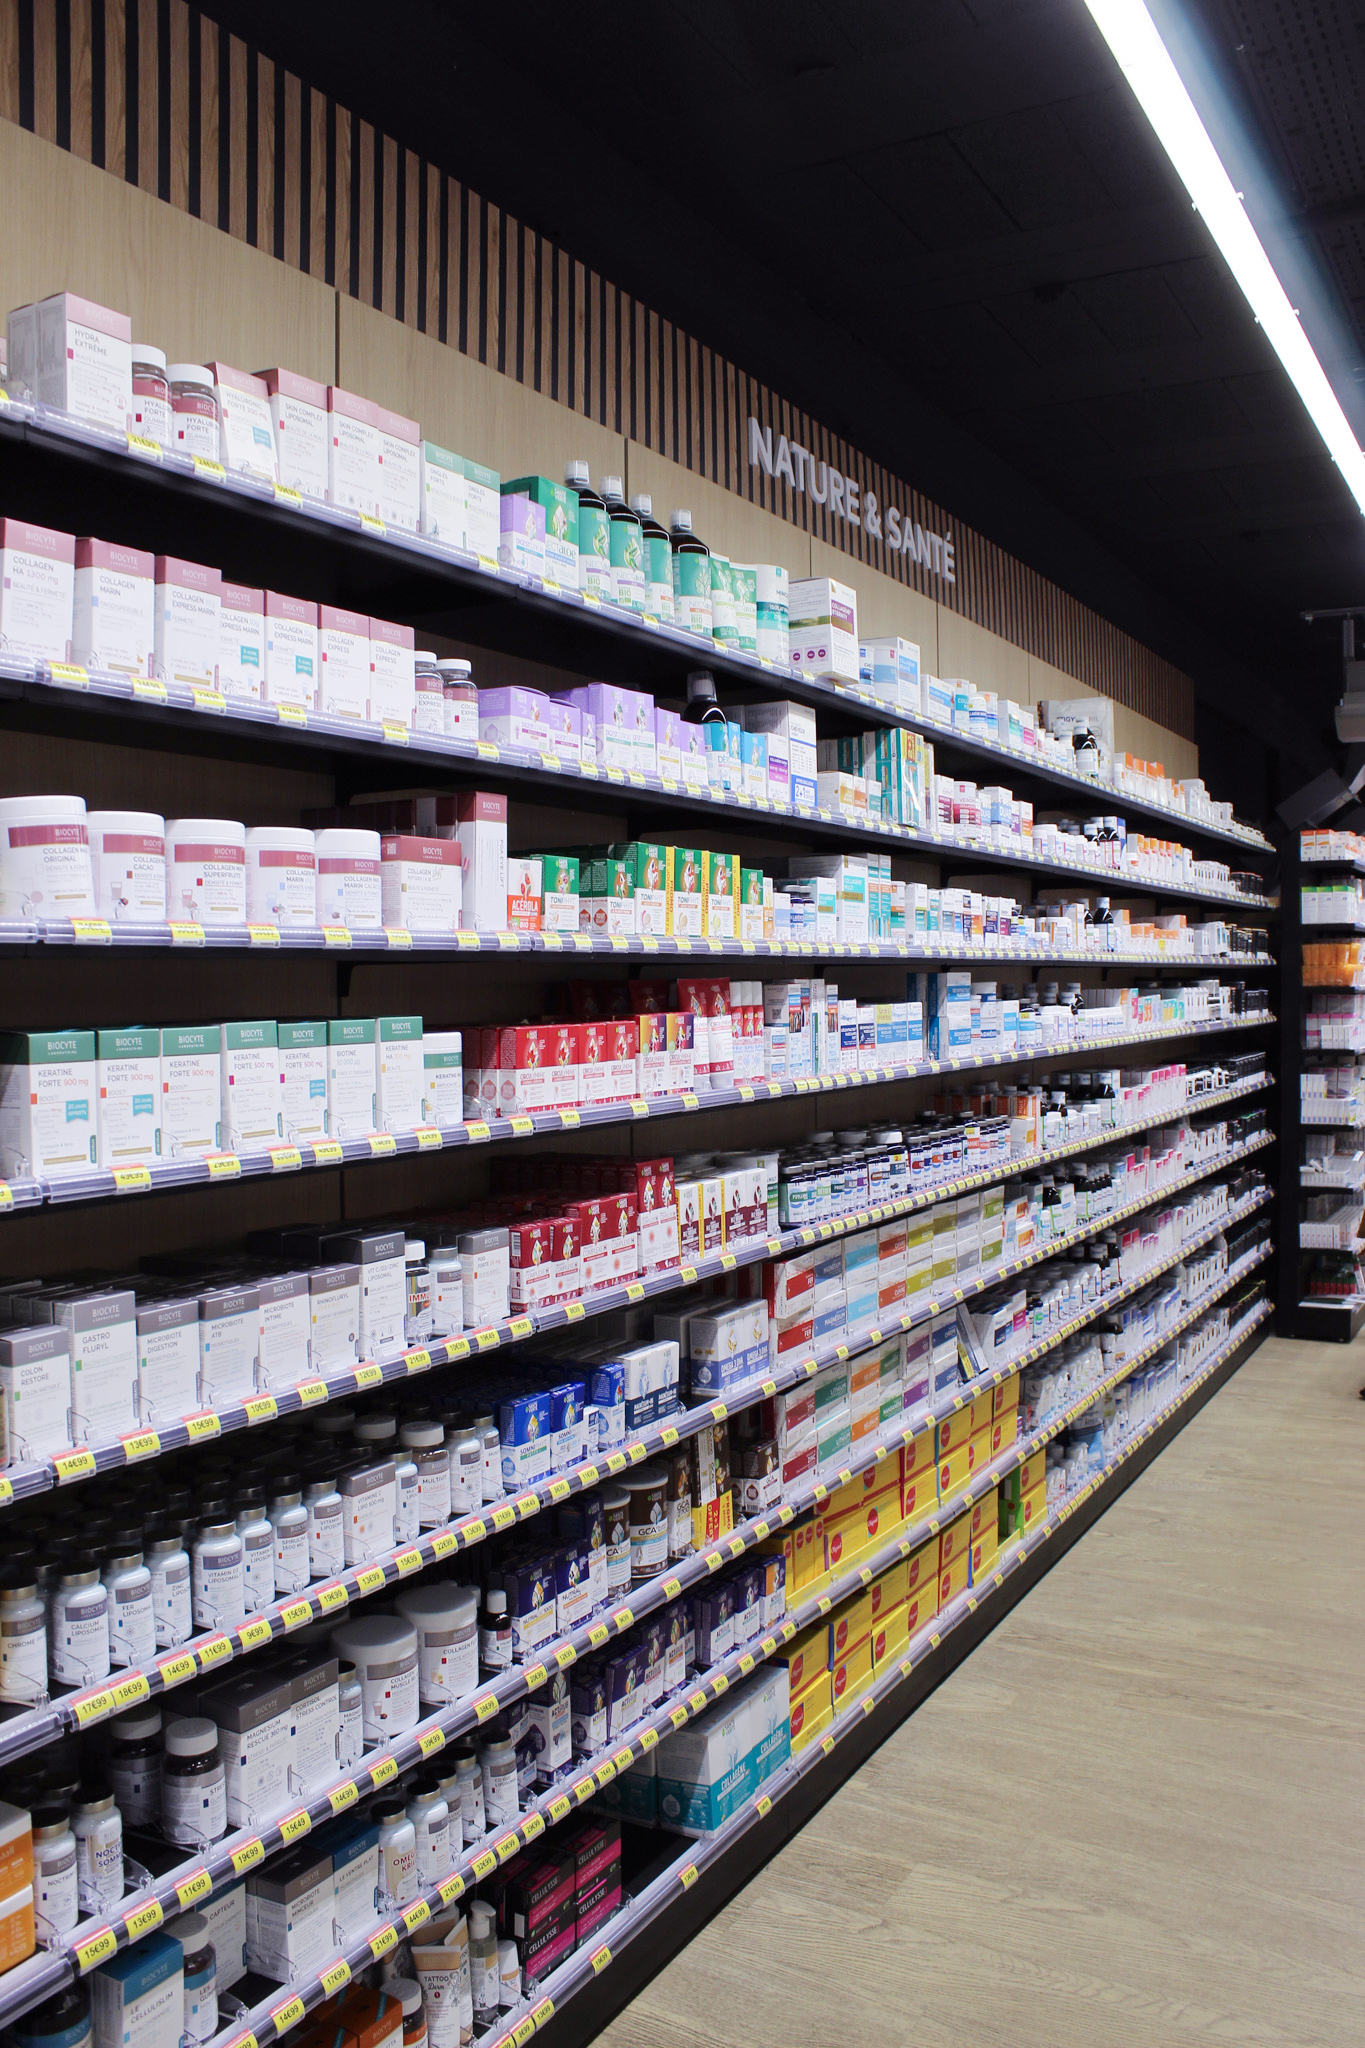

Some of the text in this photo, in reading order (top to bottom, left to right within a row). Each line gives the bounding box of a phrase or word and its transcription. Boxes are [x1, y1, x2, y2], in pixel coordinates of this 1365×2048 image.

[74, 328, 99, 343] HYDRA
[74, 338, 108, 357] EXTRÊME
[285, 412, 314, 427] LIPOSOMAL
[299, 407, 323, 422] COMPLEX
[186, 424, 209, 434] FORTE
[748, 417, 956, 583] NATURE & SANTÉ
[26, 532, 57, 547] BIOCYTE
[13, 556, 54, 572] COLLAGEN
[110, 552, 138, 565] BIOCYTE
[13, 568, 24, 576] HA
[182, 568, 207, 582] BIOCYTE
[100, 575, 136, 590] COLLAGEN
[588, 577, 600, 585] BIO
[100, 585, 121, 597] MARIN
[172, 591, 204, 604] COLLAGEN
[172, 600, 216, 617] EXPRESS MARIN
[274, 624, 303, 635] COLLAGEN
[274, 632, 314, 647] EXPRESS MARIN
[328, 635, 355, 647] COLLAGEN
[328, 644, 350, 654] EXPRESS
[376, 646, 401, 657] COLLAGEN
[376, 654, 397, 665] EXPRESS
[483, 801, 501, 811] BIOCYTE
[55, 828, 80, 837] BIOCYTE
[43, 847, 80, 856] COLLAGEN
[214, 848, 237, 856] BIOCYTE
[423, 847, 443, 856] BIOCYTE
[133, 856, 162, 864] COLLAGEN
[204, 872, 241, 880] SUPERFRUITS
[408, 868, 431, 876] COLLAGEN
[512, 898, 539, 912] ACÉROLA
[392, 1022, 411, 1031] BIOCYTE
[178, 1035, 205, 1044] BIOCYTE
[240, 1030, 264, 1038] BIOCYTE
[48, 1040, 77, 1050] BIOCYTE
[116, 1038, 143, 1047] BIOCYTE
[234, 1053, 262, 1061] KERATINE
[107, 1064, 139, 1072] KERATINE
[170, 1060, 201, 1068] KERATINE
[38, 1068, 73, 1077] KERATINE
[108, 1074, 129, 1082] FORTE
[144, 1074, 154, 1082] mg
[170, 1070, 191, 1078] FORTE
[38, 1078, 89, 1087] FORTE 900 mg
[375, 1242, 395, 1253] BIOCYTE
[317, 1293, 349, 1306] RHINOFLURYL
[92, 1304, 120, 1318] BIOCYTE
[264, 1302, 295, 1314] MICROBIOTE
[158, 1311, 182, 1322] BIOCYTE
[264, 1313, 282, 1323] INTIME
[212, 1318, 244, 1331] MICROBIOTE
[82, 1332, 111, 1344] GASTRO
[148, 1332, 183, 1345] MICROBIOTE
[83, 1342, 109, 1354] FLURYL
[148, 1341, 178, 1354] DIGESTION
[450, 1342, 466, 1352] 10€99
[408, 1354, 426, 1365] 21€99
[20, 1366, 44, 1377] COLON
[359, 1369, 377, 1380] 12€99
[21, 1373, 50, 1386] RESTORE
[304, 1384, 323, 1396] 14€99
[250, 1400, 272, 1413] 10€99
[192, 1418, 214, 1431] 15€99
[129, 1438, 154, 1451] 13€99
[62, 1456, 88, 1471] 14€99
[422, 1475, 447, 1485] MULTIVIT
[358, 1492, 377, 1504] VITAMINE
[638, 1527, 657, 1536] GCA
[437, 1538, 453, 1551] 22€99
[400, 1554, 418, 1566] 15€99
[208, 1570, 232, 1579] VITAMIN
[362, 1572, 380, 1585] 13€99
[172, 1583, 185, 1591] ZINC
[324, 1590, 343, 1603] 19€99
[80, 1604, 103, 1615] BIOCYTE
[287, 1606, 307, 1620] 15€99
[71, 1620, 100, 1631] CALCIUM
[72, 1625, 105, 1637] LIPOSOMAL
[247, 1626, 264, 1639] 9€99
[8, 1640, 35, 1650] CHROME
[204, 1642, 227, 1658] 11€99
[167, 1660, 190, 1677] 14€99
[118, 1682, 143, 1698] 18€99
[82, 1697, 107, 1714] 17€99
[296, 1696, 320, 1712] CORTISOL
[296, 1696, 338, 1720] STRESS CONTROL
[246, 1719, 281, 1741] MAGNESIUM
[247, 1732, 269, 1749] RESCUE
[424, 1734, 441, 1748] 39€99
[721, 1762, 746, 1791] COLLAGÈNE
[335, 1788, 354, 1804] 14€99
[286, 1814, 306, 1831] 15€49
[526, 1820, 541, 1833] 29€99
[500, 1840, 516, 1853] 19€99
[238, 1846, 259, 1865] 19€99
[476, 1857, 493, 1872] 32€99
[184, 1879, 206, 1898] 11€99
[444, 1883, 461, 1897] 21€99
[292, 1888, 320, 1910] MICROBIOTE
[210, 1900, 236, 1921] CAPTEUR
[292, 1901, 315, 1918] MINCEUR
[409, 1909, 426, 1923] 44€99
[133, 1910, 157, 1929] 13€99
[376, 1934, 393, 1950] 21€99
[84, 1939, 110, 1960] 15€99
[326, 1970, 346, 1985] 17€99
[130, 1992, 174, 2024] CELLULISLIM
[279, 2006, 299, 2024] 14€99
